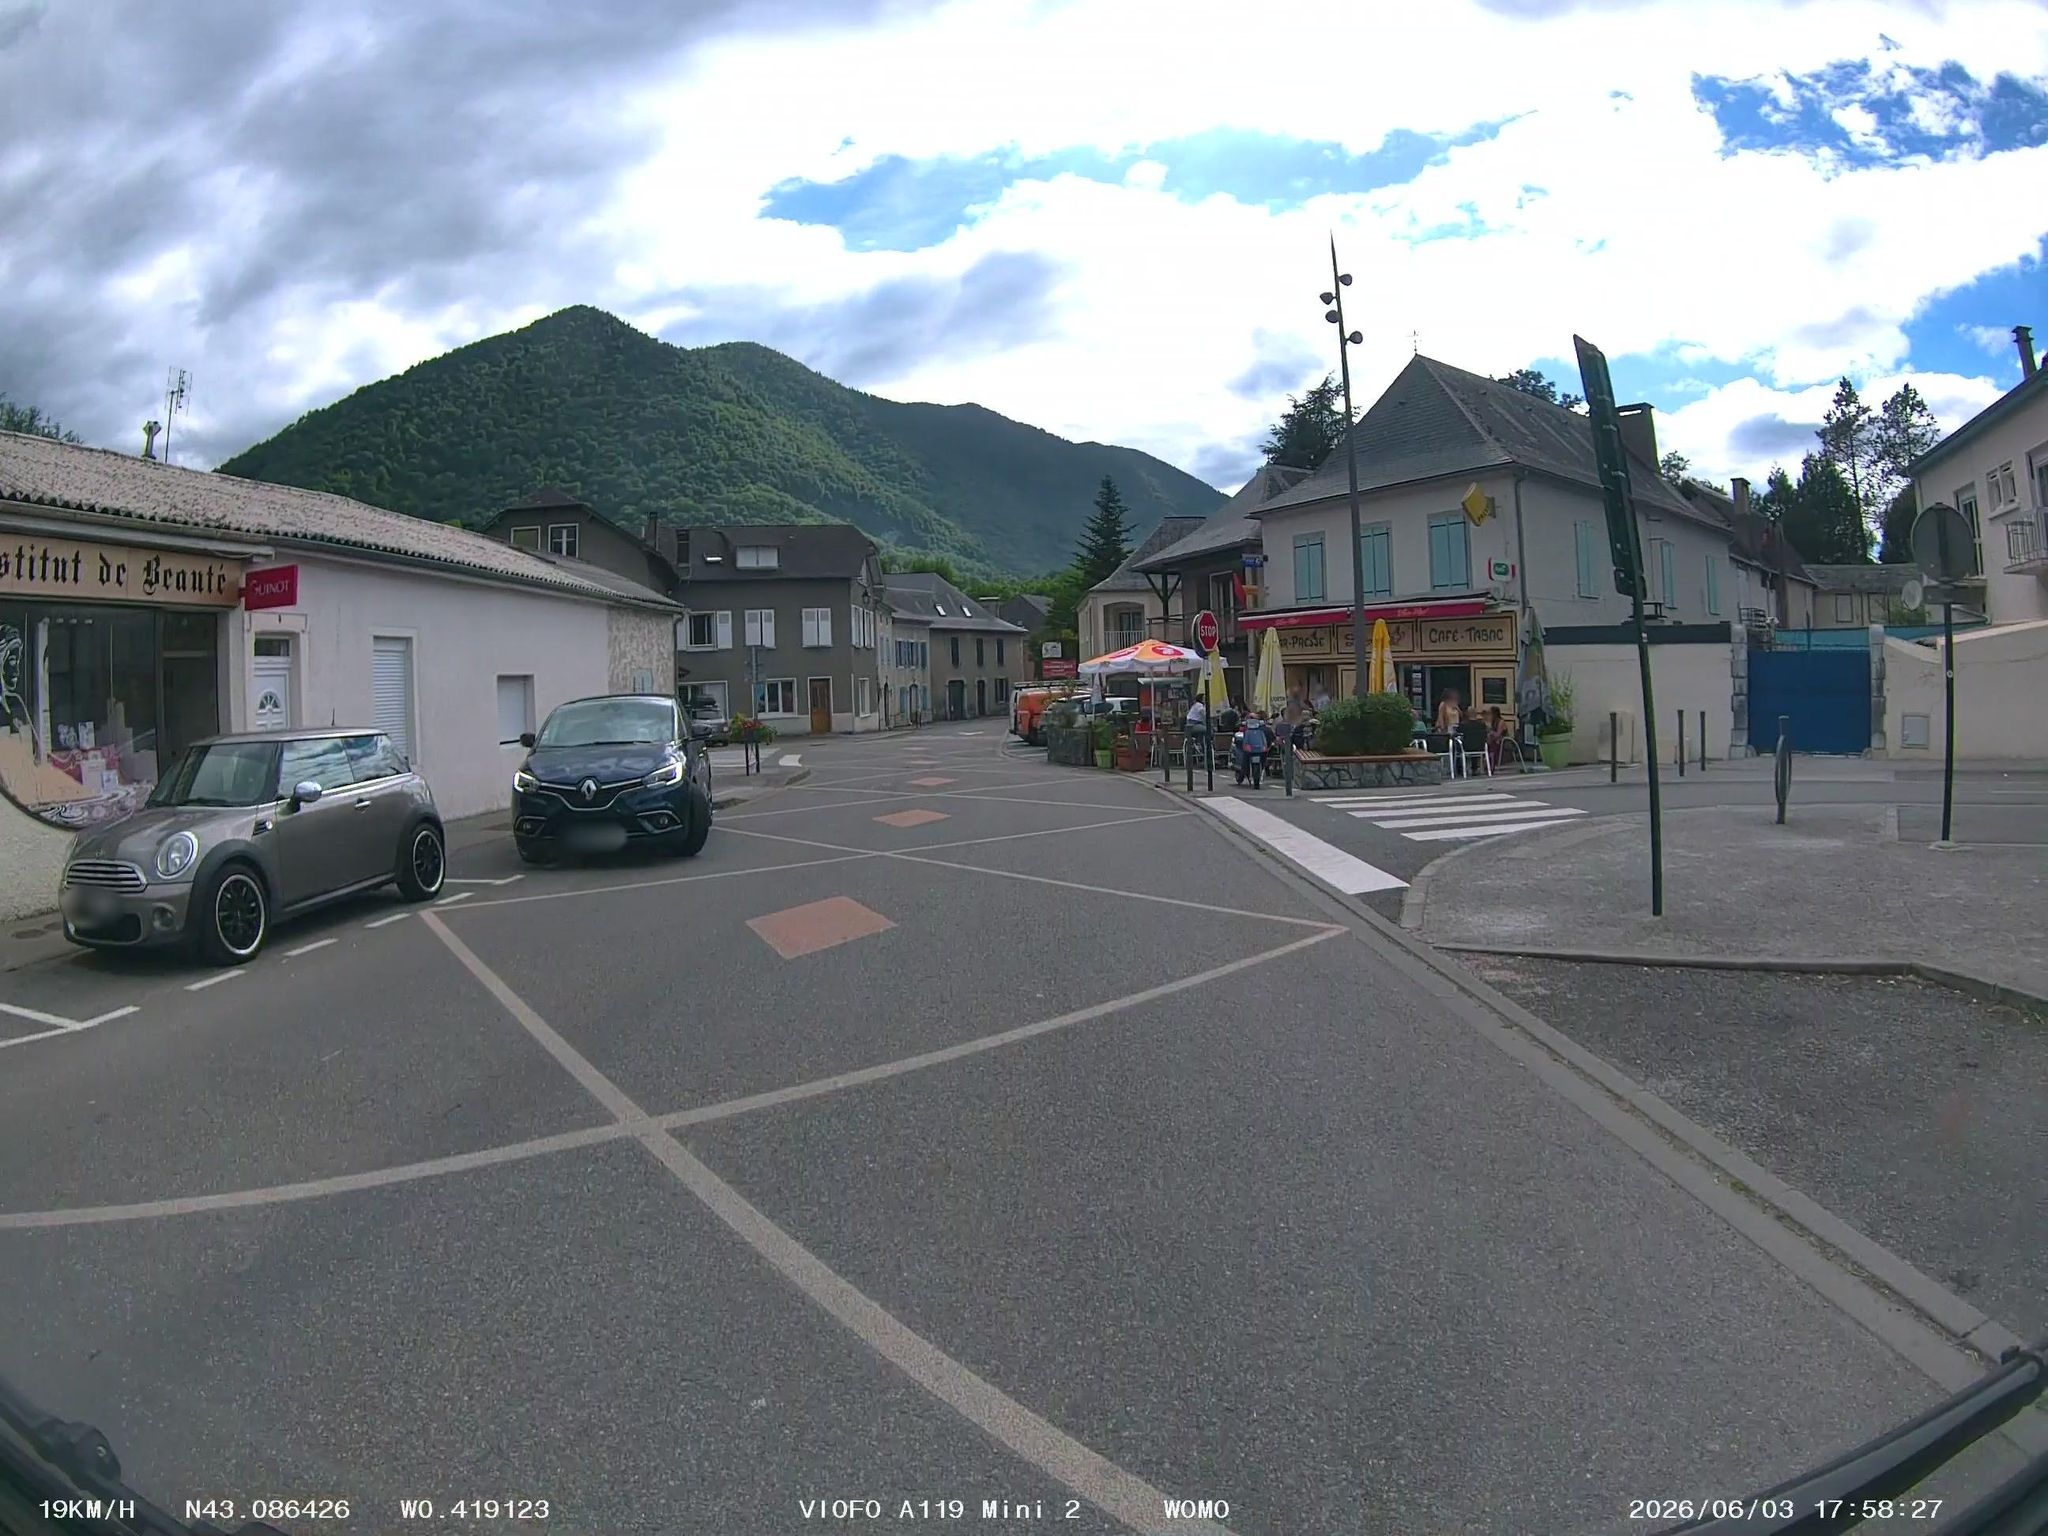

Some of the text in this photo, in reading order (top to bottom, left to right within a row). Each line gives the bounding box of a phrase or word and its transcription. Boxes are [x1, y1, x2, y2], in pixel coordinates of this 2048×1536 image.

[98, 551, 127, 587] de
[142, 553, 227, 596] Beauté
[1200, 625, 1217, 638] STOP
